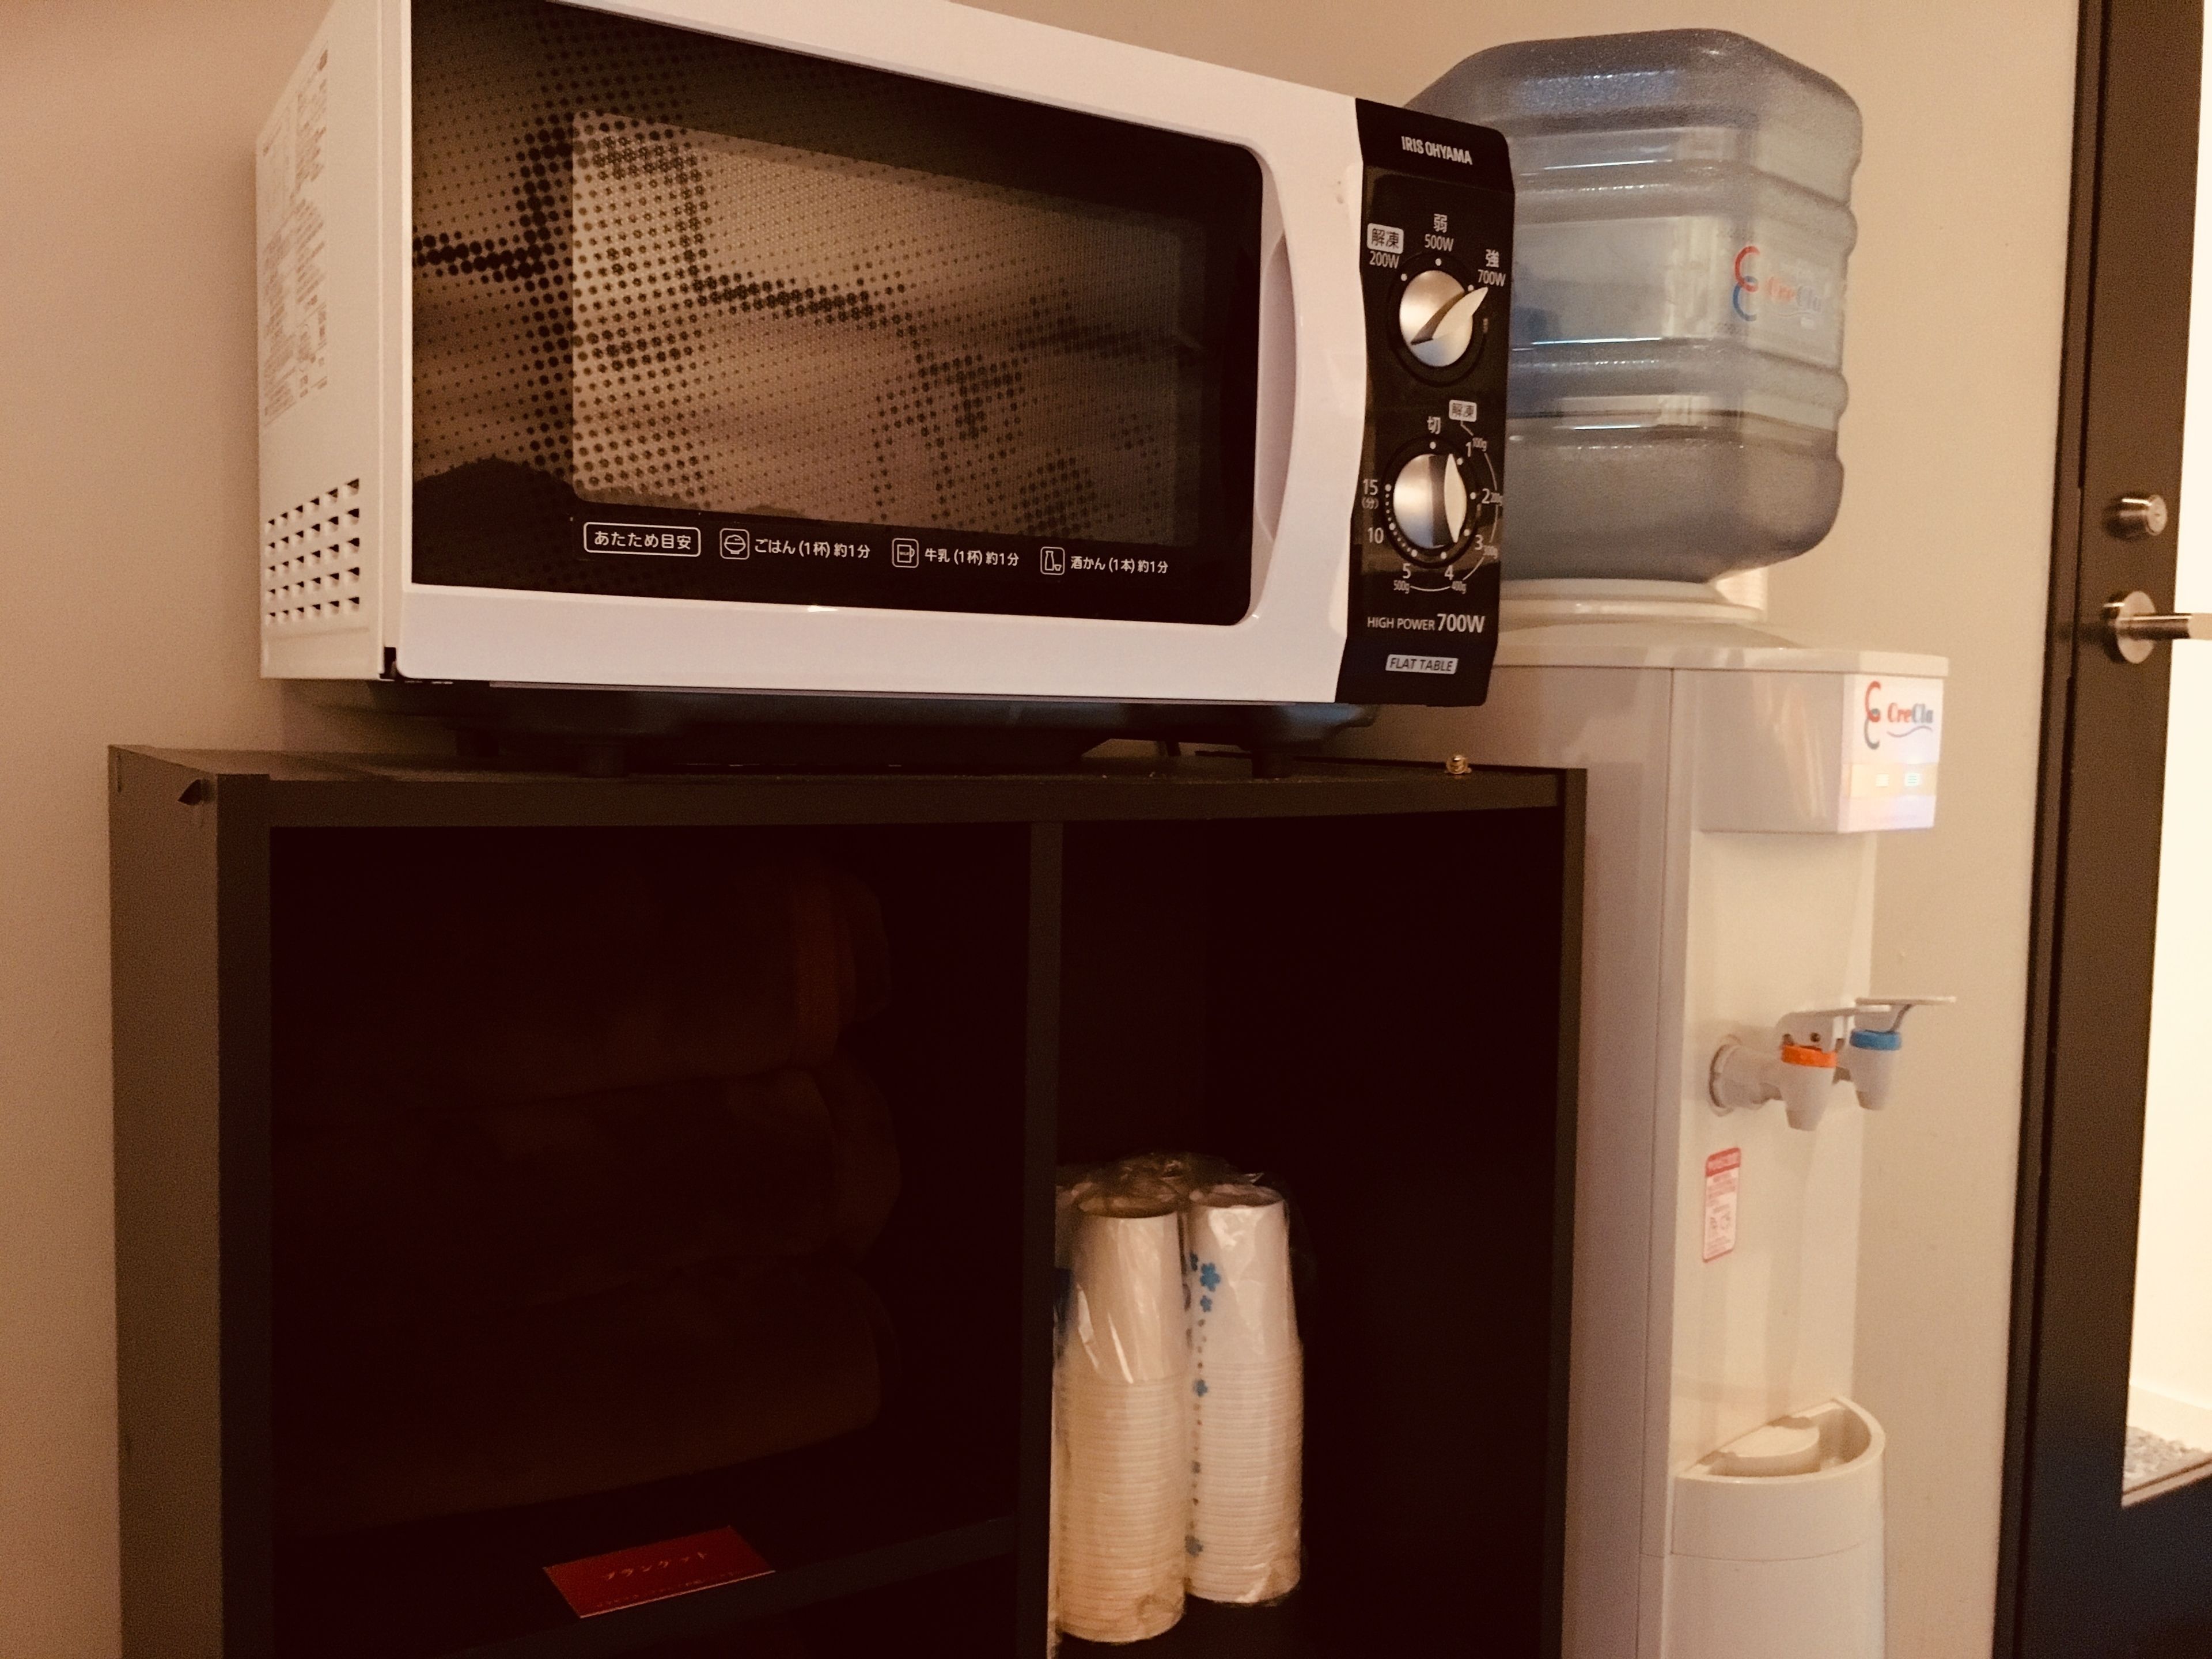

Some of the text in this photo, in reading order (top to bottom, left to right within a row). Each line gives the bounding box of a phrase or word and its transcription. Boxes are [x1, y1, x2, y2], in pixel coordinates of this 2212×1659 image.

[1401, 136, 1473, 165] IRIS OHYAMA
[1433, 214, 1448, 233] 弱
[1371, 228, 1400, 249] 解凍
[1425, 233, 1455, 252] 500W
[1369, 251, 1400, 269] 200W
[1485, 249, 1499, 268] 強
[1478, 269, 1506, 287] 700W
[1426, 416, 1441, 435] 切
[1465, 441, 1472, 457] 1
[1362, 479, 1378, 495] 15
[1481, 488, 1491, 504] 2
[594, 531, 691, 550] あたため目安
[1368, 527, 1384, 544] 10
[1474, 534, 1484, 550] 3
[1402, 563, 1411, 579] 5
[1444, 565, 1454, 581] 4
[1367, 613, 1485, 634] HIGH POWER 700W
[1389, 657, 1453, 672] FLAT TABLE
